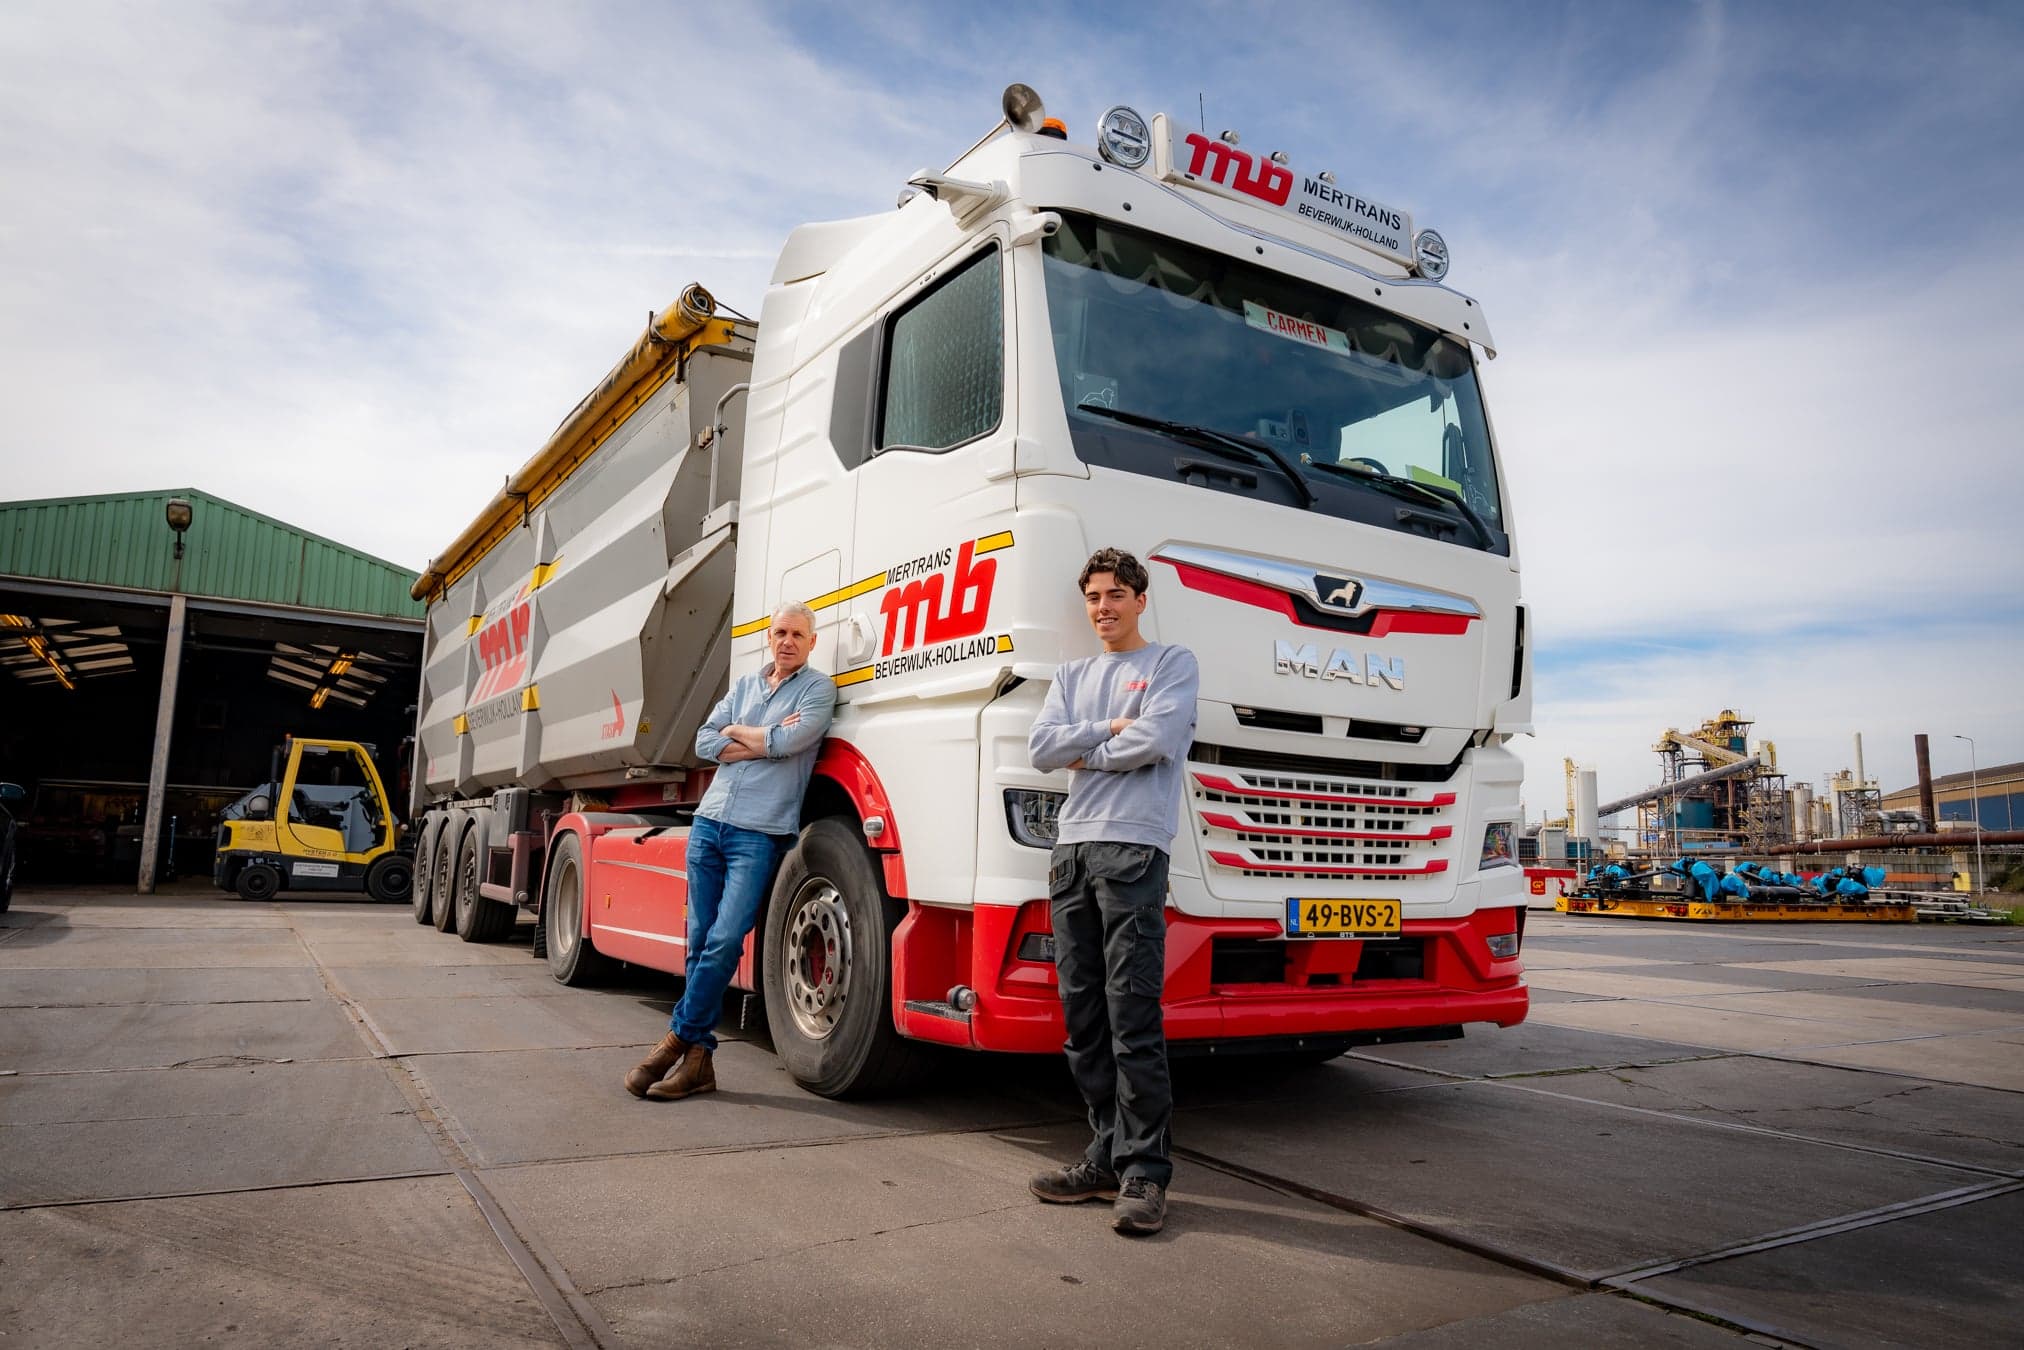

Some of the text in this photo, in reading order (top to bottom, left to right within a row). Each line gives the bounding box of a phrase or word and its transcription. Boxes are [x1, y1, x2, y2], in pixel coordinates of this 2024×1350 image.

[1303, 177, 1401, 231] MERTRANS
[1298, 203, 1399, 250] BEVERWIJK-HOLLAND
[1266, 311, 1328, 346] CARMEN
[886, 547, 952, 586] MERTRANS
[875, 636, 996, 680] BEVERWIJK-HOLLAND
[1274, 639, 1405, 691] MAN
[1306, 903, 1395, 928] 49-BVS-2
